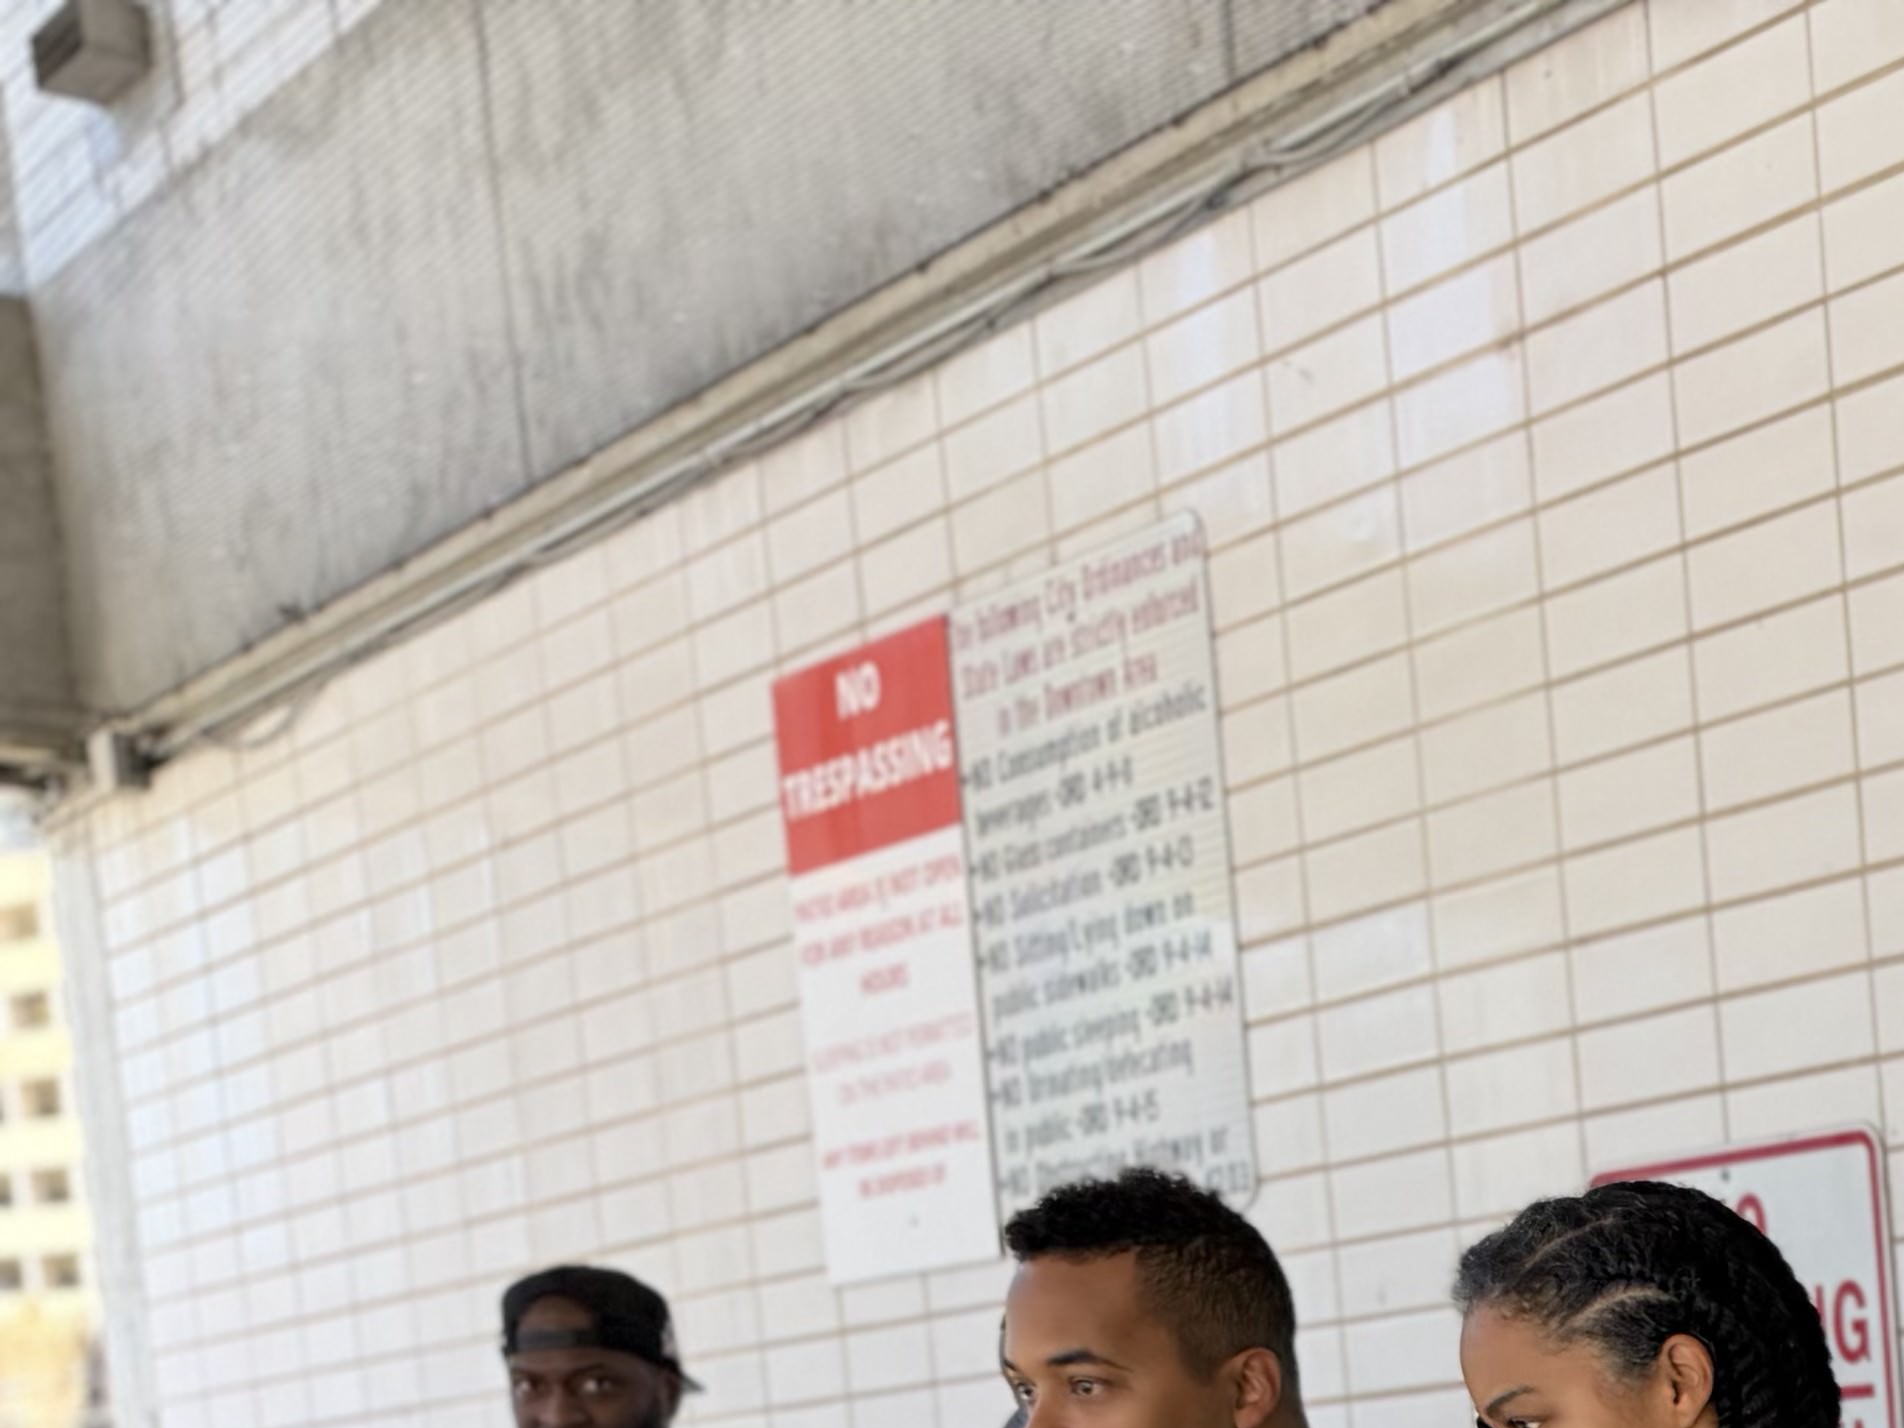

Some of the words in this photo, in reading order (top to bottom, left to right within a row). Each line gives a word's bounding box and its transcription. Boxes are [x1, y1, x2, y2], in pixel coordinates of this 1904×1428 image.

[1044, 579, 1076, 617] City
[834, 660, 882, 721] NO
[783, 718, 955, 823] TRESPASSING
